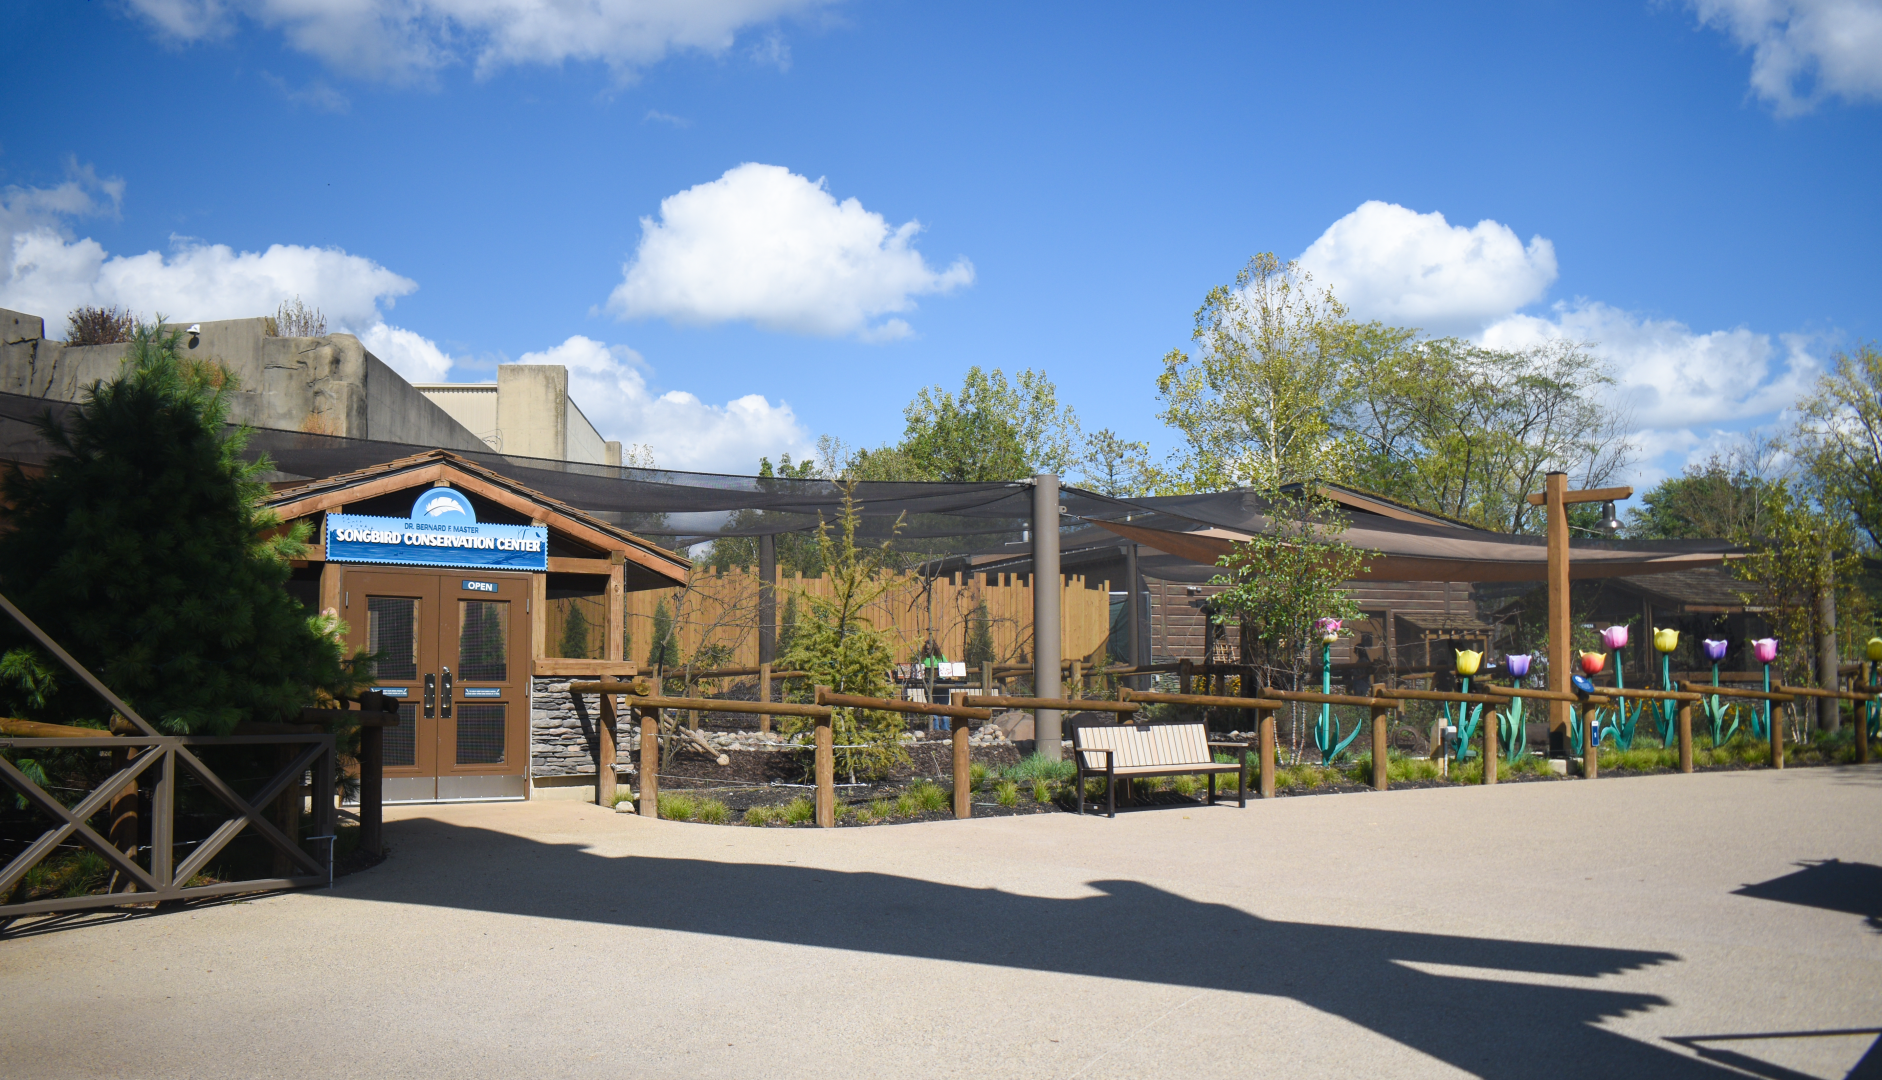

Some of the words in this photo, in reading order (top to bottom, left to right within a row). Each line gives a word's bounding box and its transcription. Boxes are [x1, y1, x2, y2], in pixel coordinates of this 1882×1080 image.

[404, 522, 414, 530] DR.
[416, 523, 446, 532] BERNARD
[453, 525, 479, 533] MASTER
[336, 529, 402, 544] SONGBIRD
[404, 533, 494, 549] CONSERVATION
[497, 538, 541, 552] CENTER
[468, 581, 493, 592] OPEN
